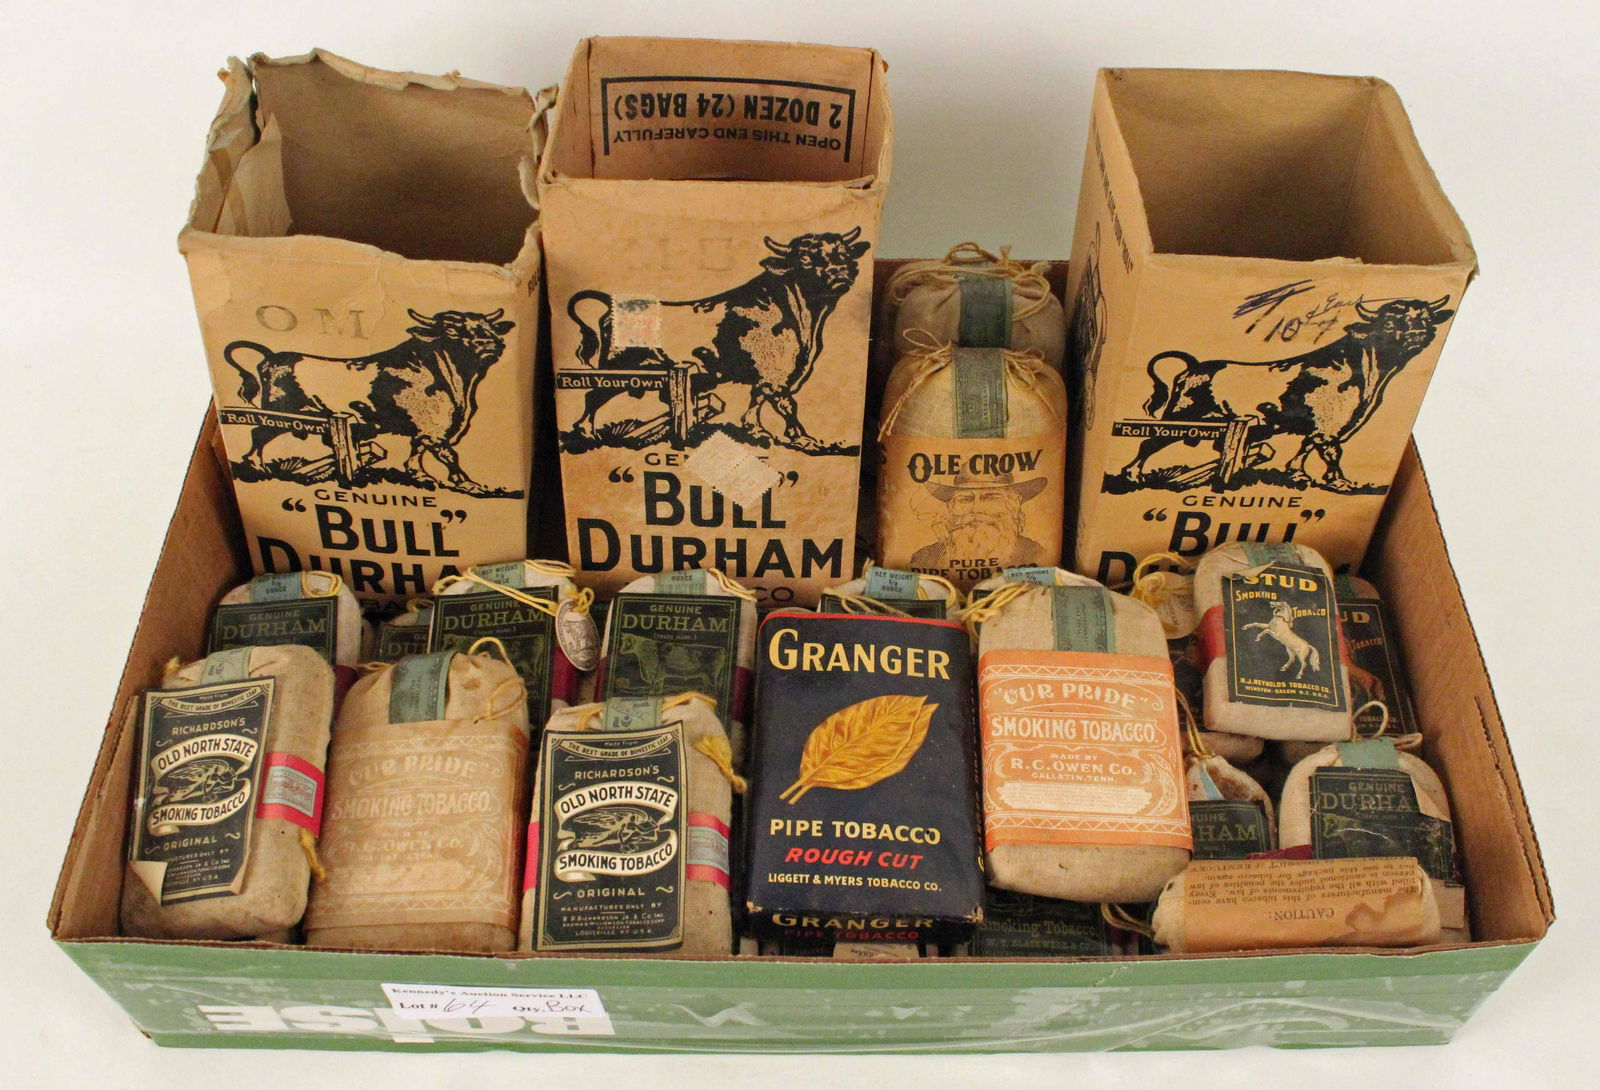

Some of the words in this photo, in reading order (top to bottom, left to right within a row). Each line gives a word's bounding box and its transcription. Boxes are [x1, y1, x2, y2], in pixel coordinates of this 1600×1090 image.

[614, 92, 687, 121] BAGS)
[697, 93, 735, 119] (24
[744, 95, 820, 126] DOZEN
[829, 103, 843, 129] 2
[613, 127, 709, 144] CAREFULLY
[714, 127, 748, 140] END
[753, 130, 790, 144] THIS
[796, 135, 841, 151] OPEN
[594, 376, 628, 388] Your
[259, 415, 292, 429] Your
[1153, 425, 1187, 438] Your
[907, 453, 961, 483] OLE
[969, 449, 1044, 477] CROW
[314, 488, 438, 508] GENUINE
[1182, 495, 1303, 508] GENUINE
[577, 517, 844, 579] DURHAM
[949, 557, 1000, 569] PURE
[1243, 573, 1318, 592] STUD
[1235, 590, 1278, 602] SMOKING
[470, 600, 520, 612] GENUINE
[650, 604, 703, 615] GENUINE
[1293, 606, 1327, 619] TOBACCO
[249, 609, 300, 621] GENUINE
[444, 608, 546, 631] DURHAM
[221, 618, 327, 640] DURHAM
[621, 614, 729, 633] DURHAM
[769, 628, 951, 681] GRANGER
[1289, 681, 1320, 691] TOBACCO
[171, 717, 246, 736] RICHARDSON'S
[991, 717, 1076, 740] SMOKING
[1080, 719, 1159, 744] TOBACCO.
[157, 749, 181, 771] OLD
[183, 738, 220, 758] NORTH
[221, 737, 255, 758] STATE
[568, 742, 580, 751] THE
[582, 747, 598, 756] BEST
[1049, 753, 1082, 761] MADE
[574, 765, 660, 780] RICHARDSON'S
[1348, 782, 1405, 793] GENUINE
[560, 793, 586, 814] OLD
[588, 785, 633, 805] NORTH
[634, 785, 675, 808] STATE
[1318, 792, 1414, 813] DURHA
[152, 806, 199, 825] SMOKING
[200, 791, 246, 821] TOBACCO
[332, 797, 413, 820] SMOKING
[770, 818, 824, 837] PIPE
[832, 821, 941, 845] TOBACCO
[162, 836, 218, 852] ORIGINAL
[558, 853, 618, 871] SMOKING
[619, 843, 673, 871] TOBACCO
[784, 847, 873, 867] ROUGH
[877, 851, 924, 870] CUT
[768, 873, 811, 884] LIGGETT
[812, 874, 822, 884] &
[824, 875, 863, 887] MYERS
[867, 877, 921, 890] TOBACCO
[924, 882, 942, 892] CO.
[576, 888, 646, 899] ORIGINAL
[1188, 890, 1217, 898] Every
[1242, 895, 1277, 903] tobacco
[1321, 887, 1392, 898] manufacturers
[561, 904, 624, 912] MANUFACTURED
[771, 912, 936, 930] GRANGER
[980, 919, 1041, 937] Smoking
[835, 931, 920, 941] TOBACCO
[391, 988, 456, 997] Kennedy's
[461, 990, 508, 998] Auction
[400, 1001, 426, 1009] Lot
